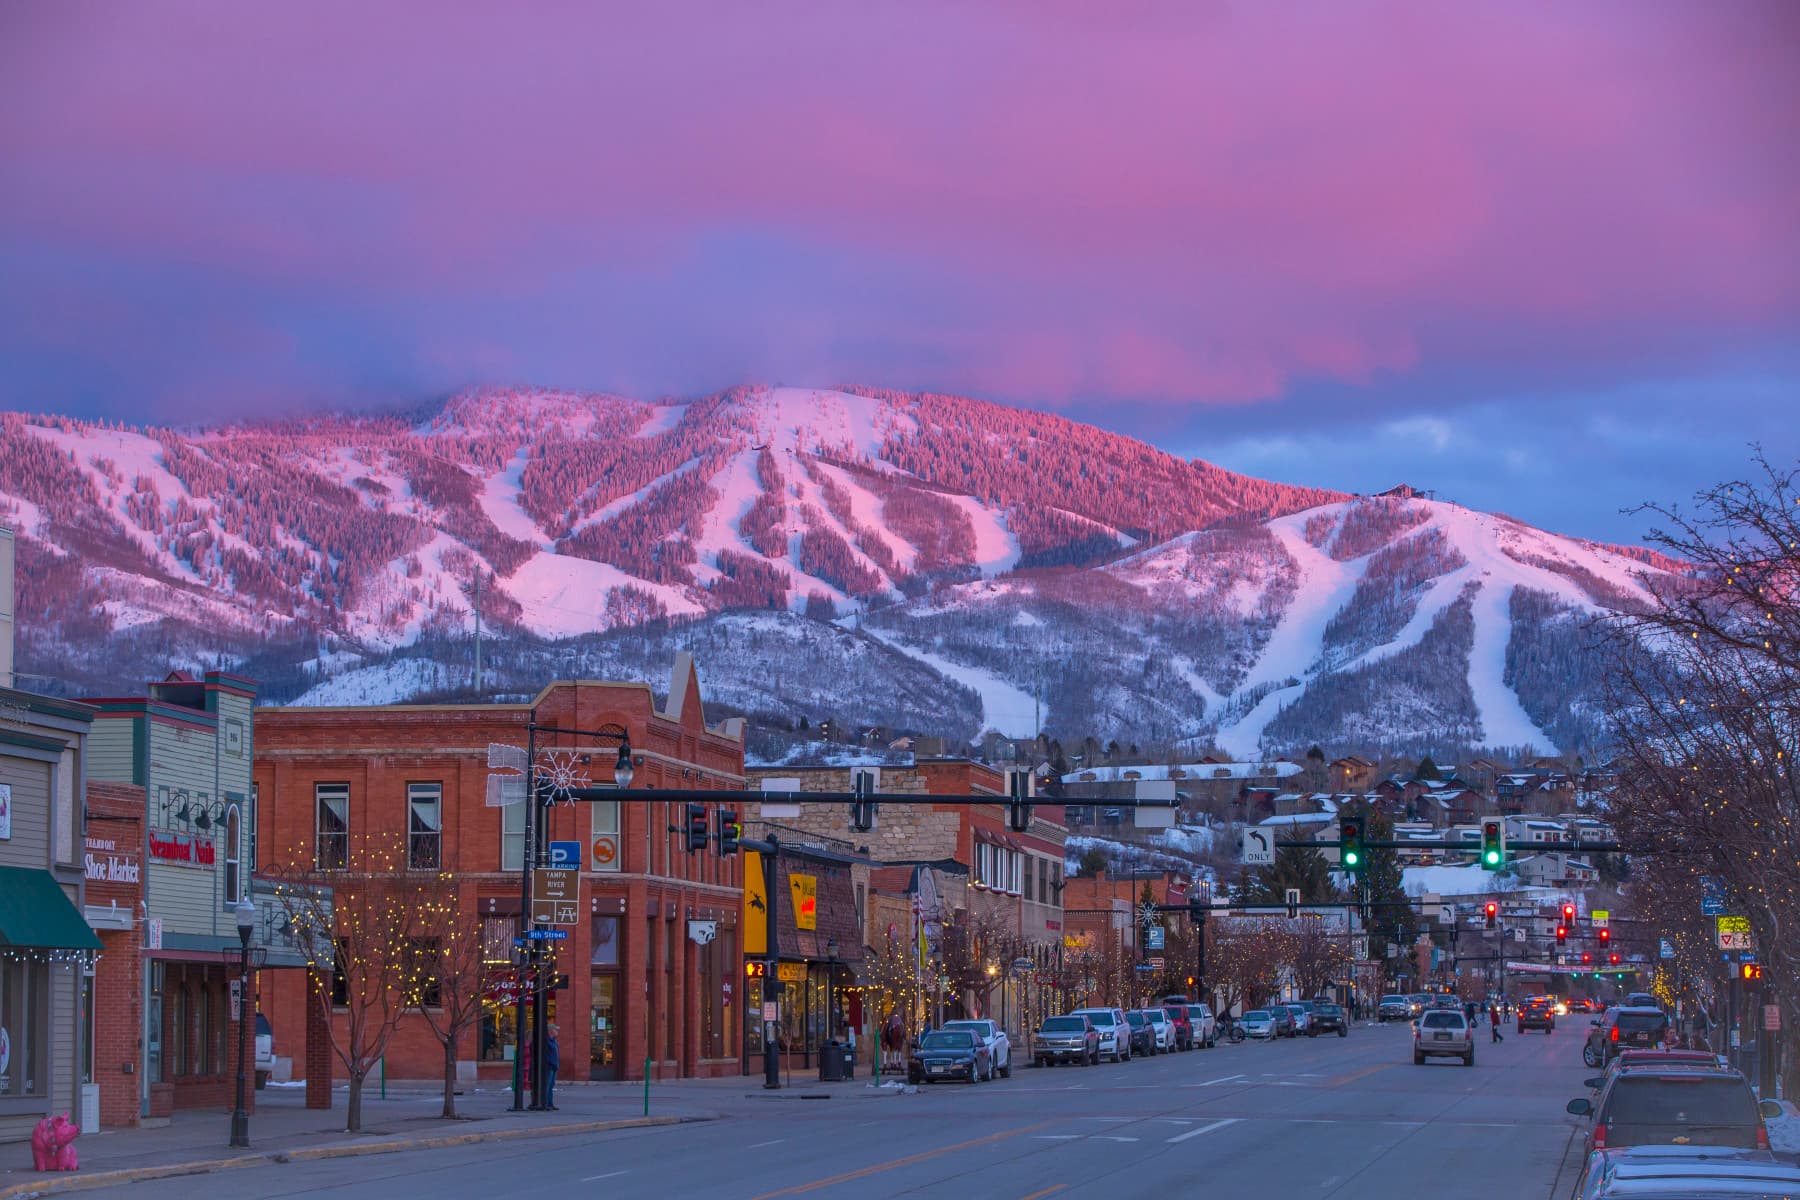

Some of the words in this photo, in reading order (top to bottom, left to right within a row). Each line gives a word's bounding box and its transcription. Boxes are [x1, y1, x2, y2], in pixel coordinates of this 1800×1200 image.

[149, 831, 192, 861] Steamboat
[194, 839, 216, 865] Nails
[1248, 853, 1270, 861] ONLY
[84, 853, 106, 880] Shoe
[107, 856, 140, 883] Market
[547, 881, 565, 889] RIVER
[757, 963, 763, 976] 2
